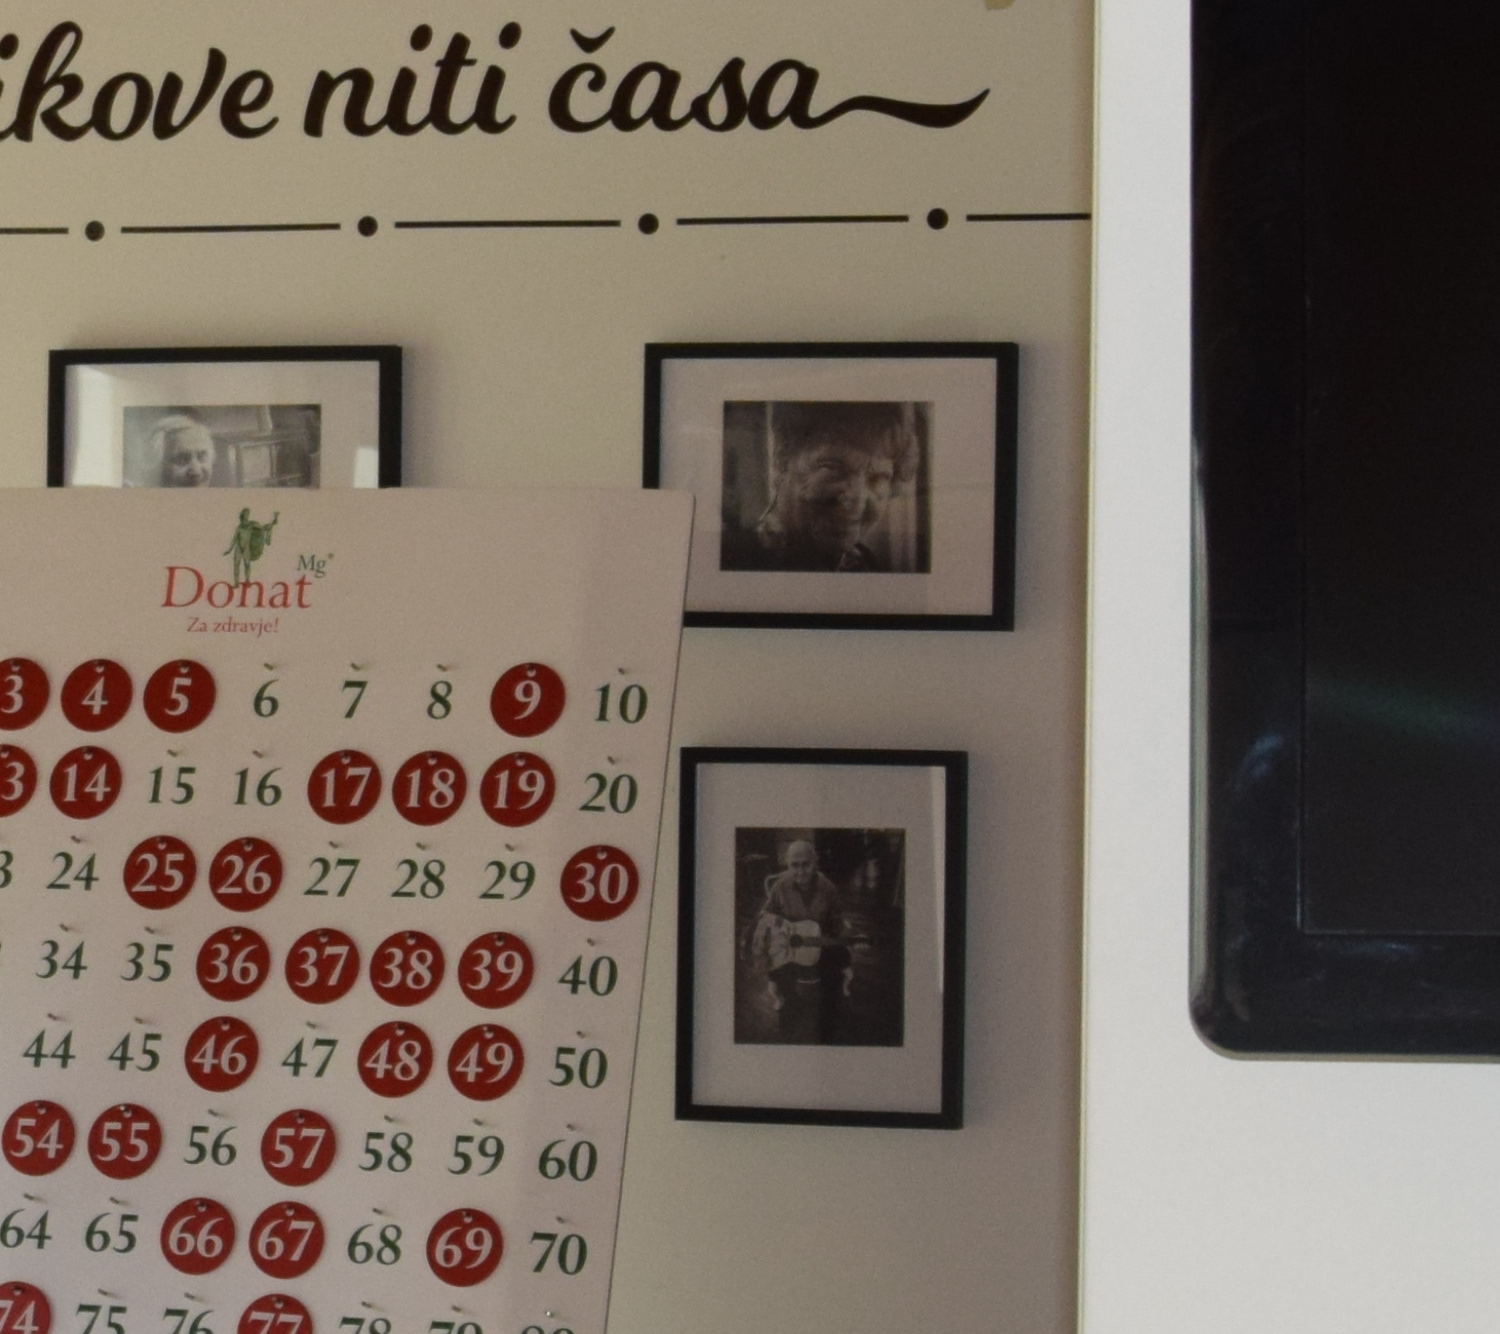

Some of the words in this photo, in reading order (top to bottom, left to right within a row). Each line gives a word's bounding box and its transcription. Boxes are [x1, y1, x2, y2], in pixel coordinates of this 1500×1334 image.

[303, 22, 522, 138] niti
[548, 26, 990, 141] časa
[161, 565, 313, 609] Donat
[186, 617, 208, 634] Za
[213, 616, 280, 638] zdravje!
[1, 674, 24, 714] 3
[81, 676, 108, 715] 4
[165, 677, 192, 716] 5
[253, 680, 279, 718] 6
[342, 680, 368, 719] 7
[427, 680, 453, 720] 8
[514, 679, 541, 720] 9
[596, 684, 648, 724] 10
[63, 763, 111, 802] 14
[149, 766, 196, 805] 15
[234, 768, 282, 807] 16
[322, 766, 372, 807] 17
[407, 768, 455, 809] 18
[494, 769, 546, 809] 19
[579, 772, 638, 814] 20
[46, 851, 99, 891] 24
[131, 852, 185, 892] 25
[216, 854, 272, 895] 26
[303, 857, 361, 897] 27
[391, 858, 446, 899] 28
[479, 860, 536, 900] 29
[571, 862, 629, 904] 30
[37, 939, 88, 980] 34
[122, 942, 174, 982] 35
[206, 943, 259, 985] 36
[295, 945, 350, 987] 37
[379, 947, 433, 990] 38
[467, 948, 524, 991] 39
[558, 955, 618, 997] 40
[22, 1029, 76, 1069] 44
[107, 1033, 162, 1072] 45
[192, 1034, 247, 1075] 46
[281, 1038, 338, 1078] 47
[365, 1039, 422, 1081] 48
[455, 1042, 514, 1083] 49
[550, 1046, 608, 1089] 50
[10, 1117, 63, 1159] 54
[97, 1121, 150, 1162] 55
[184, 1125, 237, 1166] 56
[270, 1127, 326, 1169] 57
[359, 1131, 413, 1173] 58
[449, 1135, 505, 1176] 59
[538, 1139, 598, 1182] 60
[0, 1209, 52, 1250] 64
[84, 1213, 139, 1254] 65
[168, 1215, 223, 1258] 66
[257, 1219, 315, 1262] 67
[347, 1224, 402, 1265] 68
[434, 1226, 493, 1269] 69
[531, 1231, 588, 1275] 70
